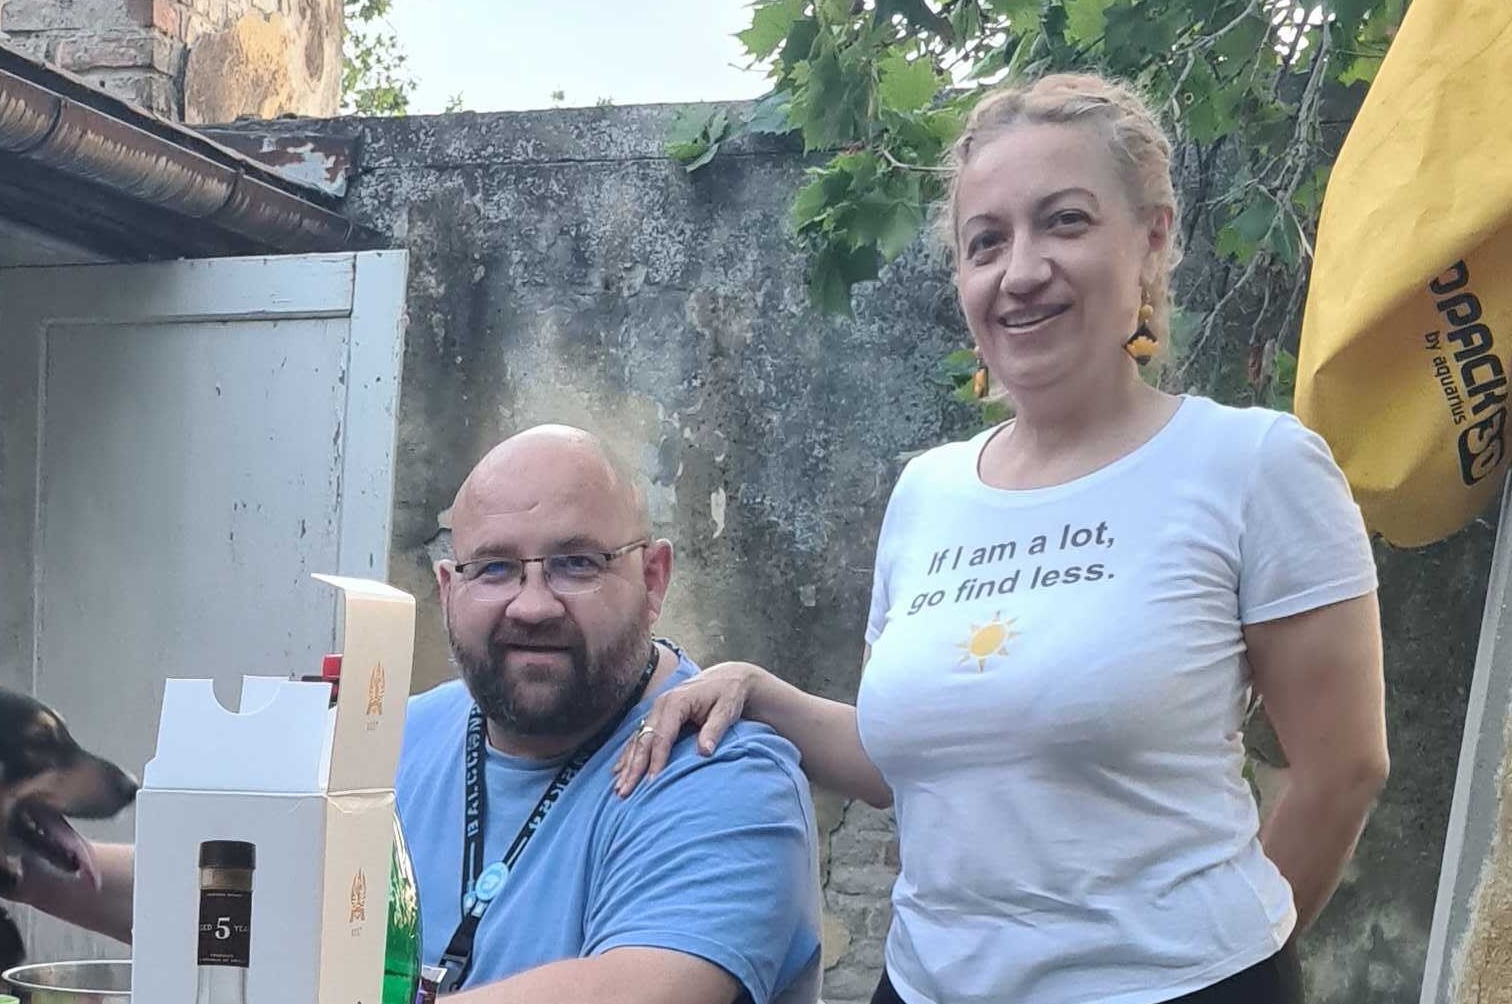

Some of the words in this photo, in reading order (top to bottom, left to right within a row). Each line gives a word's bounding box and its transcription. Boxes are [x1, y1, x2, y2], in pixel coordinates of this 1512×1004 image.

[1425, 331, 1441, 351] by
[1433, 354, 1467, 426] aquarius
[927, 548, 951, 576] If
[952, 545, 964, 571] I
[968, 540, 1017, 567] am
[1028, 534, 1048, 556] a
[1059, 521, 1115, 550] lot,
[906, 589, 946, 616] go
[954, 569, 1021, 603] find
[1030, 562, 1115, 590] less.
[215, 917, 231, 940] 5
